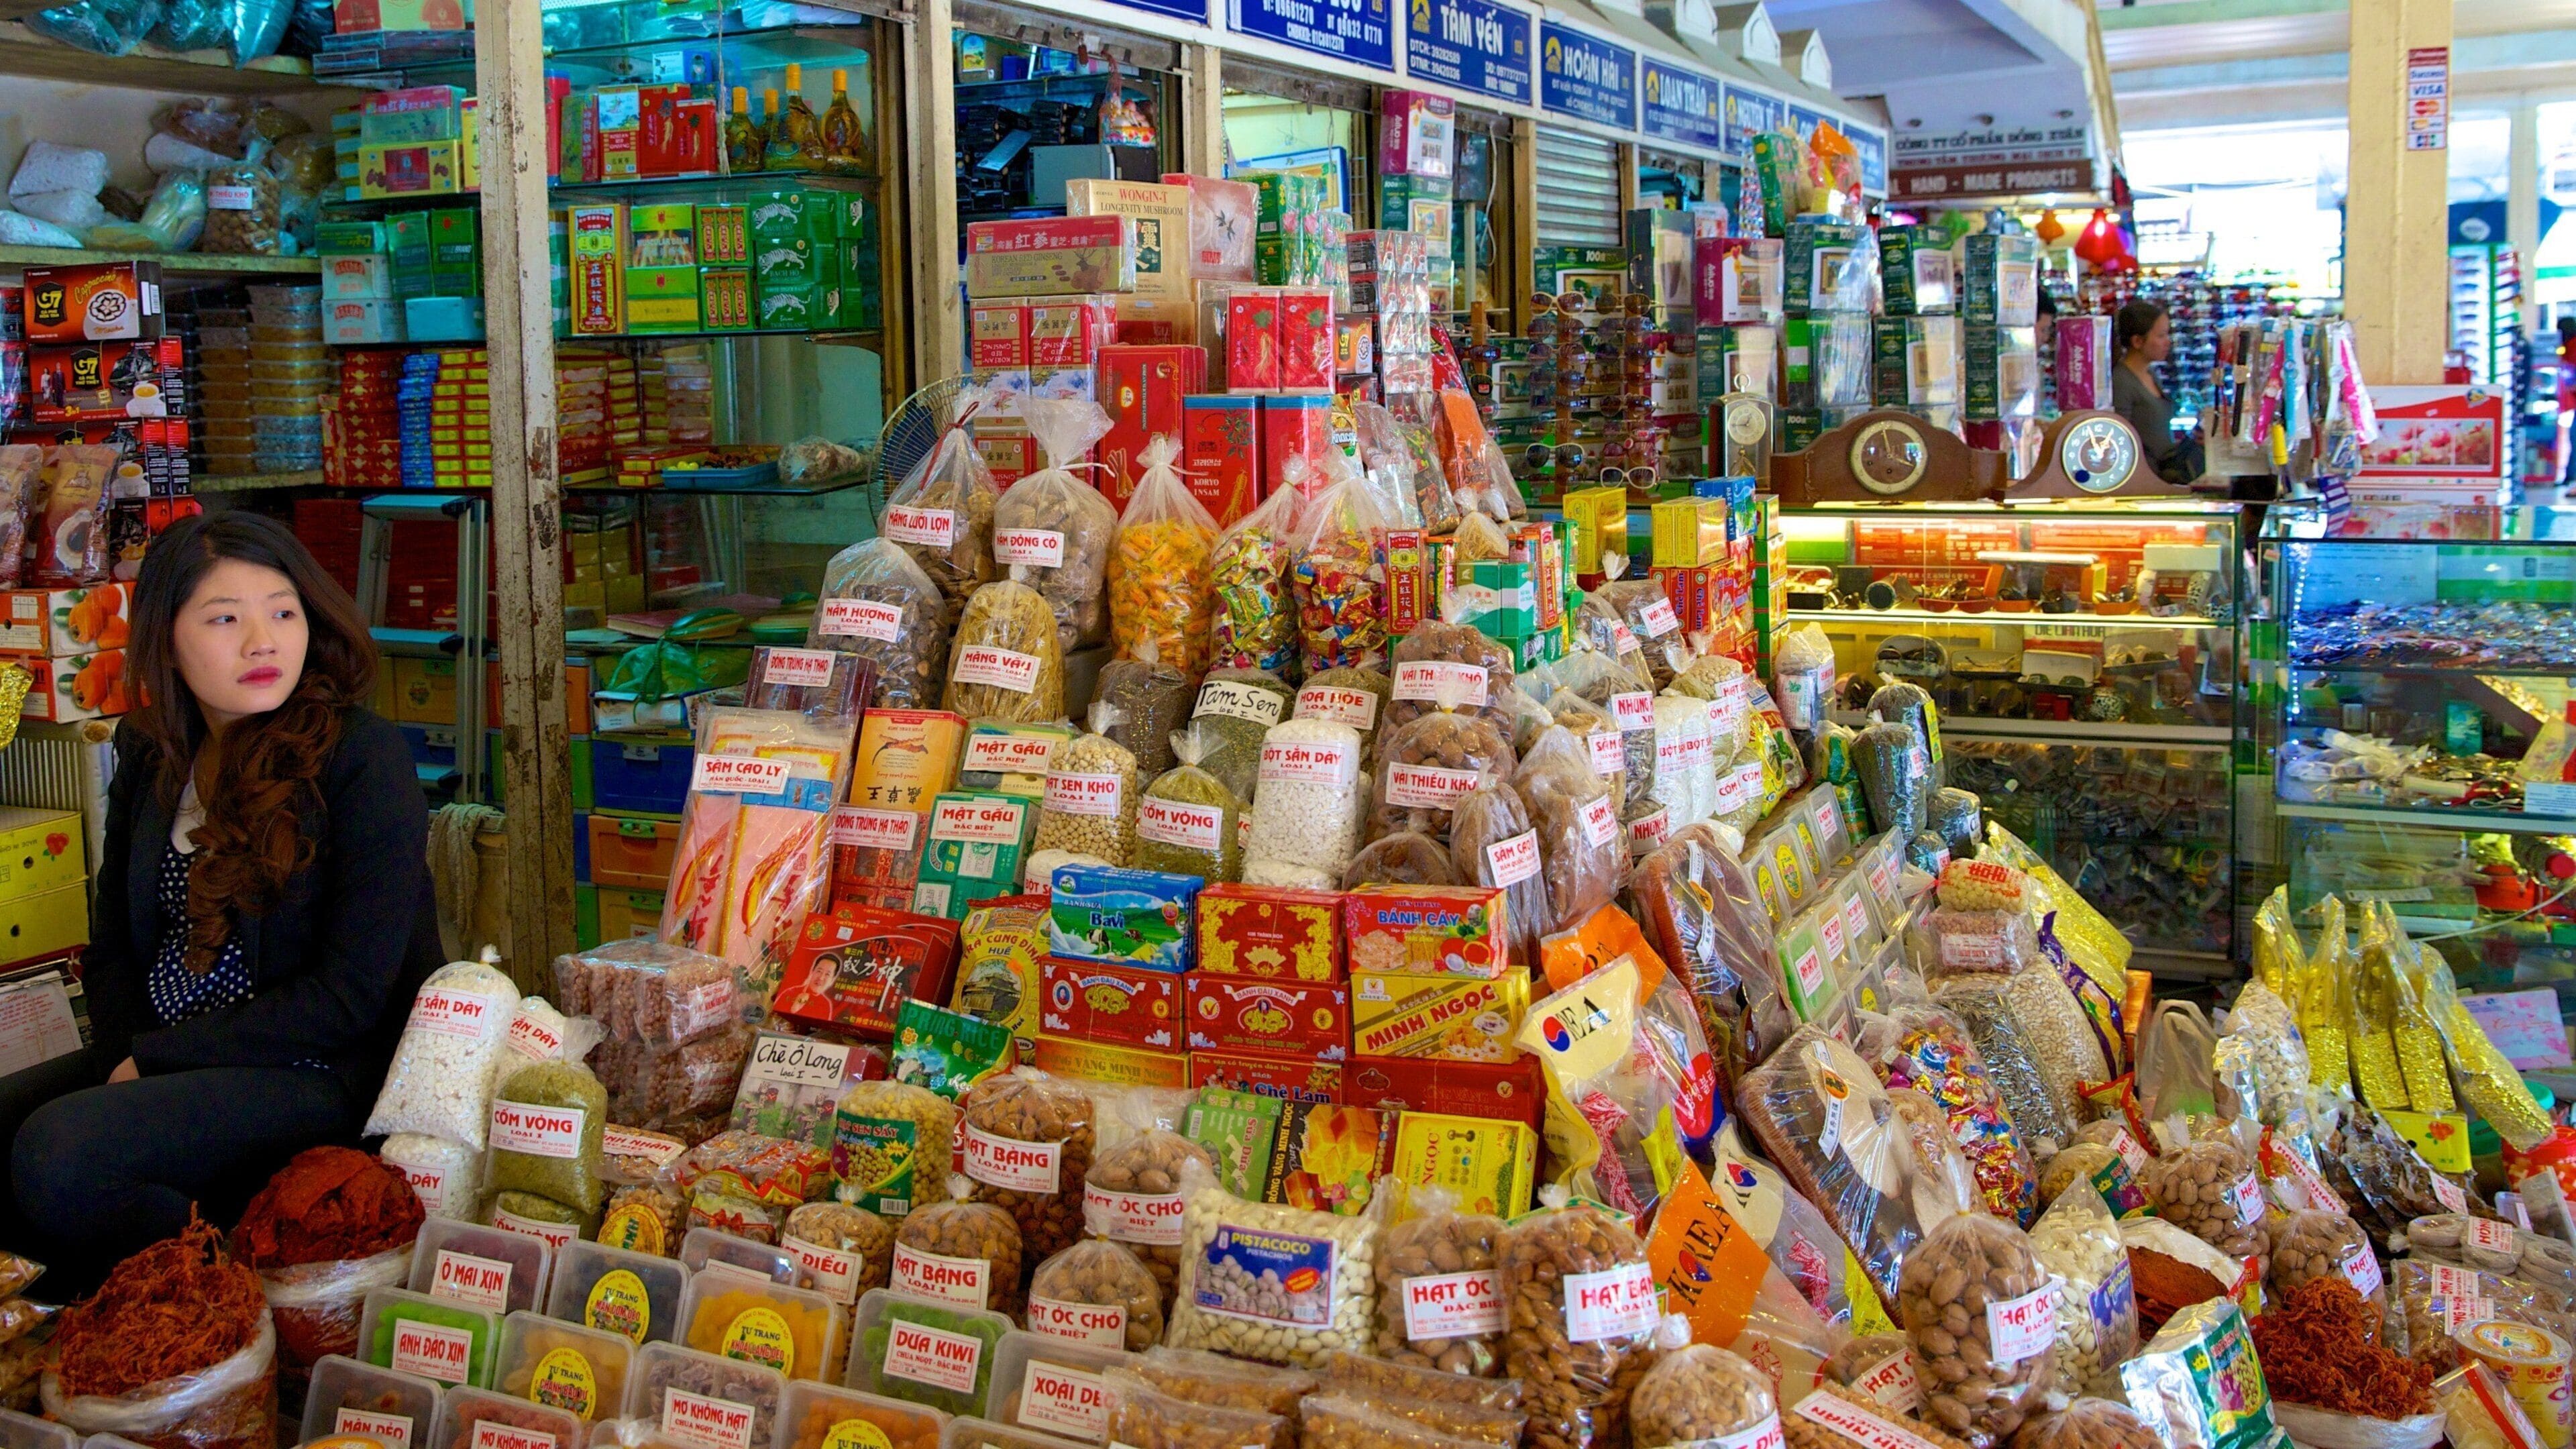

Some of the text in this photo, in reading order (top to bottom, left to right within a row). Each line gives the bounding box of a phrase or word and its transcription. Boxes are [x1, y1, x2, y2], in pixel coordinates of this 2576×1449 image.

[1441, 1, 1503, 56] TÂM YẾN
[1564, 43, 1619, 91] HOÀN HẢI
[1659, 74, 1683, 111] LOAN
[2415, 85, 2443, 95] VISA
[1933, 137, 1947, 148] TY
[1963, 172, 2002, 191] MADE
[2006, 168, 2077, 189] PRODUCTS
[1119, 189, 1167, 202] WONGIN-T
[1100, 203, 1183, 216] LONGEVITY MUSHROOM
[74, 272, 116, 305] Cappuccino
[37, 291, 63, 307] G7
[74, 358, 99, 374] G7
[930, 517, 950, 533] LỢN
[1010, 534, 1038, 547] ĐÔNG
[1696, 588, 1705, 607] Chè
[826, 602, 895, 623] NẤM HƯƠNG
[814, 655, 828, 672] THẢO
[1242, 690, 1279, 716] Sen
[1301, 692, 1324, 704] HOA
[1618, 698, 1649, 716] NHUNG
[975, 741, 1046, 756] MẬT GẤU
[1264, 744, 1342, 765] BỘT SẮN DÂY
[706, 758, 782, 777] SÂM CAO LY
[1062, 780, 1083, 792] SEN
[1087, 778, 1115, 794] KHÔ
[1053, 793, 1084, 802] LOẠI
[943, 806, 1014, 823] MẬT GẤU
[1144, 802, 1214, 828] CỐM VÒNG
[890, 815, 908, 835] THẢO
[973, 824, 995, 833] BIỆT
[1494, 841, 1534, 863] SÂM CAO
[1379, 908, 1461, 927] BÁNH CÁY
[986, 934, 1018, 945] CUNG
[988, 945, 1014, 956] HUẾ
[1116, 981, 1135, 994] XANH
[1273, 990, 1294, 1004] XANH
[425, 993, 483, 1018] SẮN DÂY
[1366, 983, 1499, 1052] MINH NGỌC
[789, 1043, 805, 1065] Ô
[805, 1047, 843, 1079] Long
[1254, 1082, 1332, 1104] Chè Lam
[494, 1106, 573, 1134] CỐM VÒNG
[852, 1121, 900, 1139] SEN SẤY
[511, 1129, 533, 1138] LOẠI
[965, 1136, 1049, 1169] HẠT BÀNG
[977, 1159, 1009, 1173] LOẠI
[1118, 1193, 1141, 1214] ÓC
[1146, 1194, 1185, 1216] CHÓ
[1231, 1232, 1311, 1255] PISTACOCO
[802, 1253, 849, 1277] ĐIỀU
[896, 1253, 977, 1287] HẠT BÀNG
[441, 1258, 504, 1294] Ô MAI XỊN
[618, 1289, 639, 1303] TRANG
[1413, 1275, 1492, 1305] HẠT ÓC
[1580, 1283, 1619, 1310] HẠT
[1053, 1303, 1075, 1324] ÓC
[1081, 1307, 1121, 1329] CHÓ
[2000, 1289, 2051, 1329] HẠT ÓC
[400, 1332, 420, 1352] ANH
[447, 1341, 466, 1366] XỊN
[936, 1340, 973, 1364] KIWI
[540, 1378, 561, 1394] CHANH
[1034, 1375, 1074, 1399] XOÀI
[674, 1400, 749, 1430] MƠ KHÔNG HẠT
